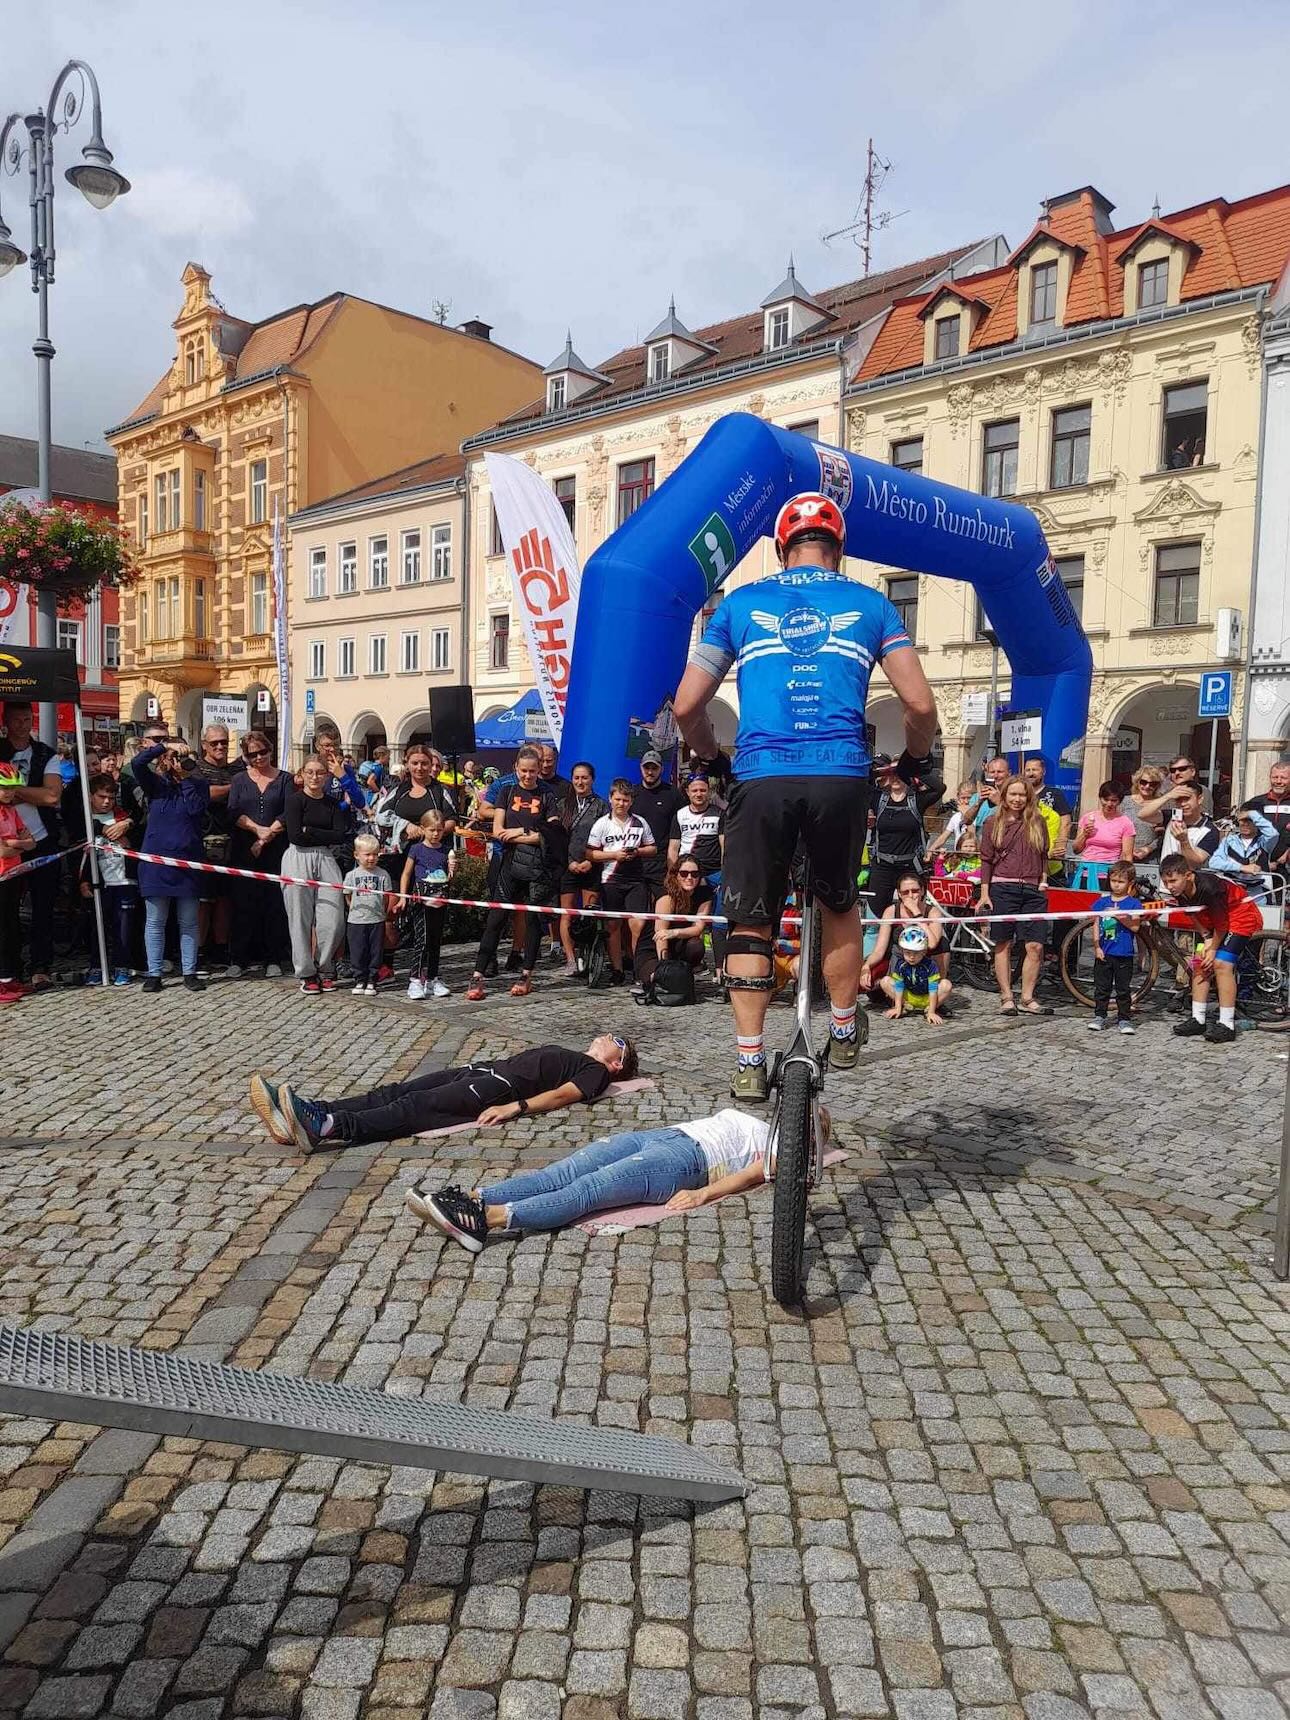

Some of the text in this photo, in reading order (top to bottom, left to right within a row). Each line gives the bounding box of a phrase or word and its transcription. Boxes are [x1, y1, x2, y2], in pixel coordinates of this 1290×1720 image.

[723, 472, 757, 514] Městské
[737, 478, 776, 534] informační
[865, 474, 1016, 549] Město Rumburk
[1206, 676, 1226, 703] P
[227, 716, 238, 724] km
[1020, 737, 1031, 746] km
[770, 750, 805, 763] SLEEP
[816, 749, 836, 763] EAT
